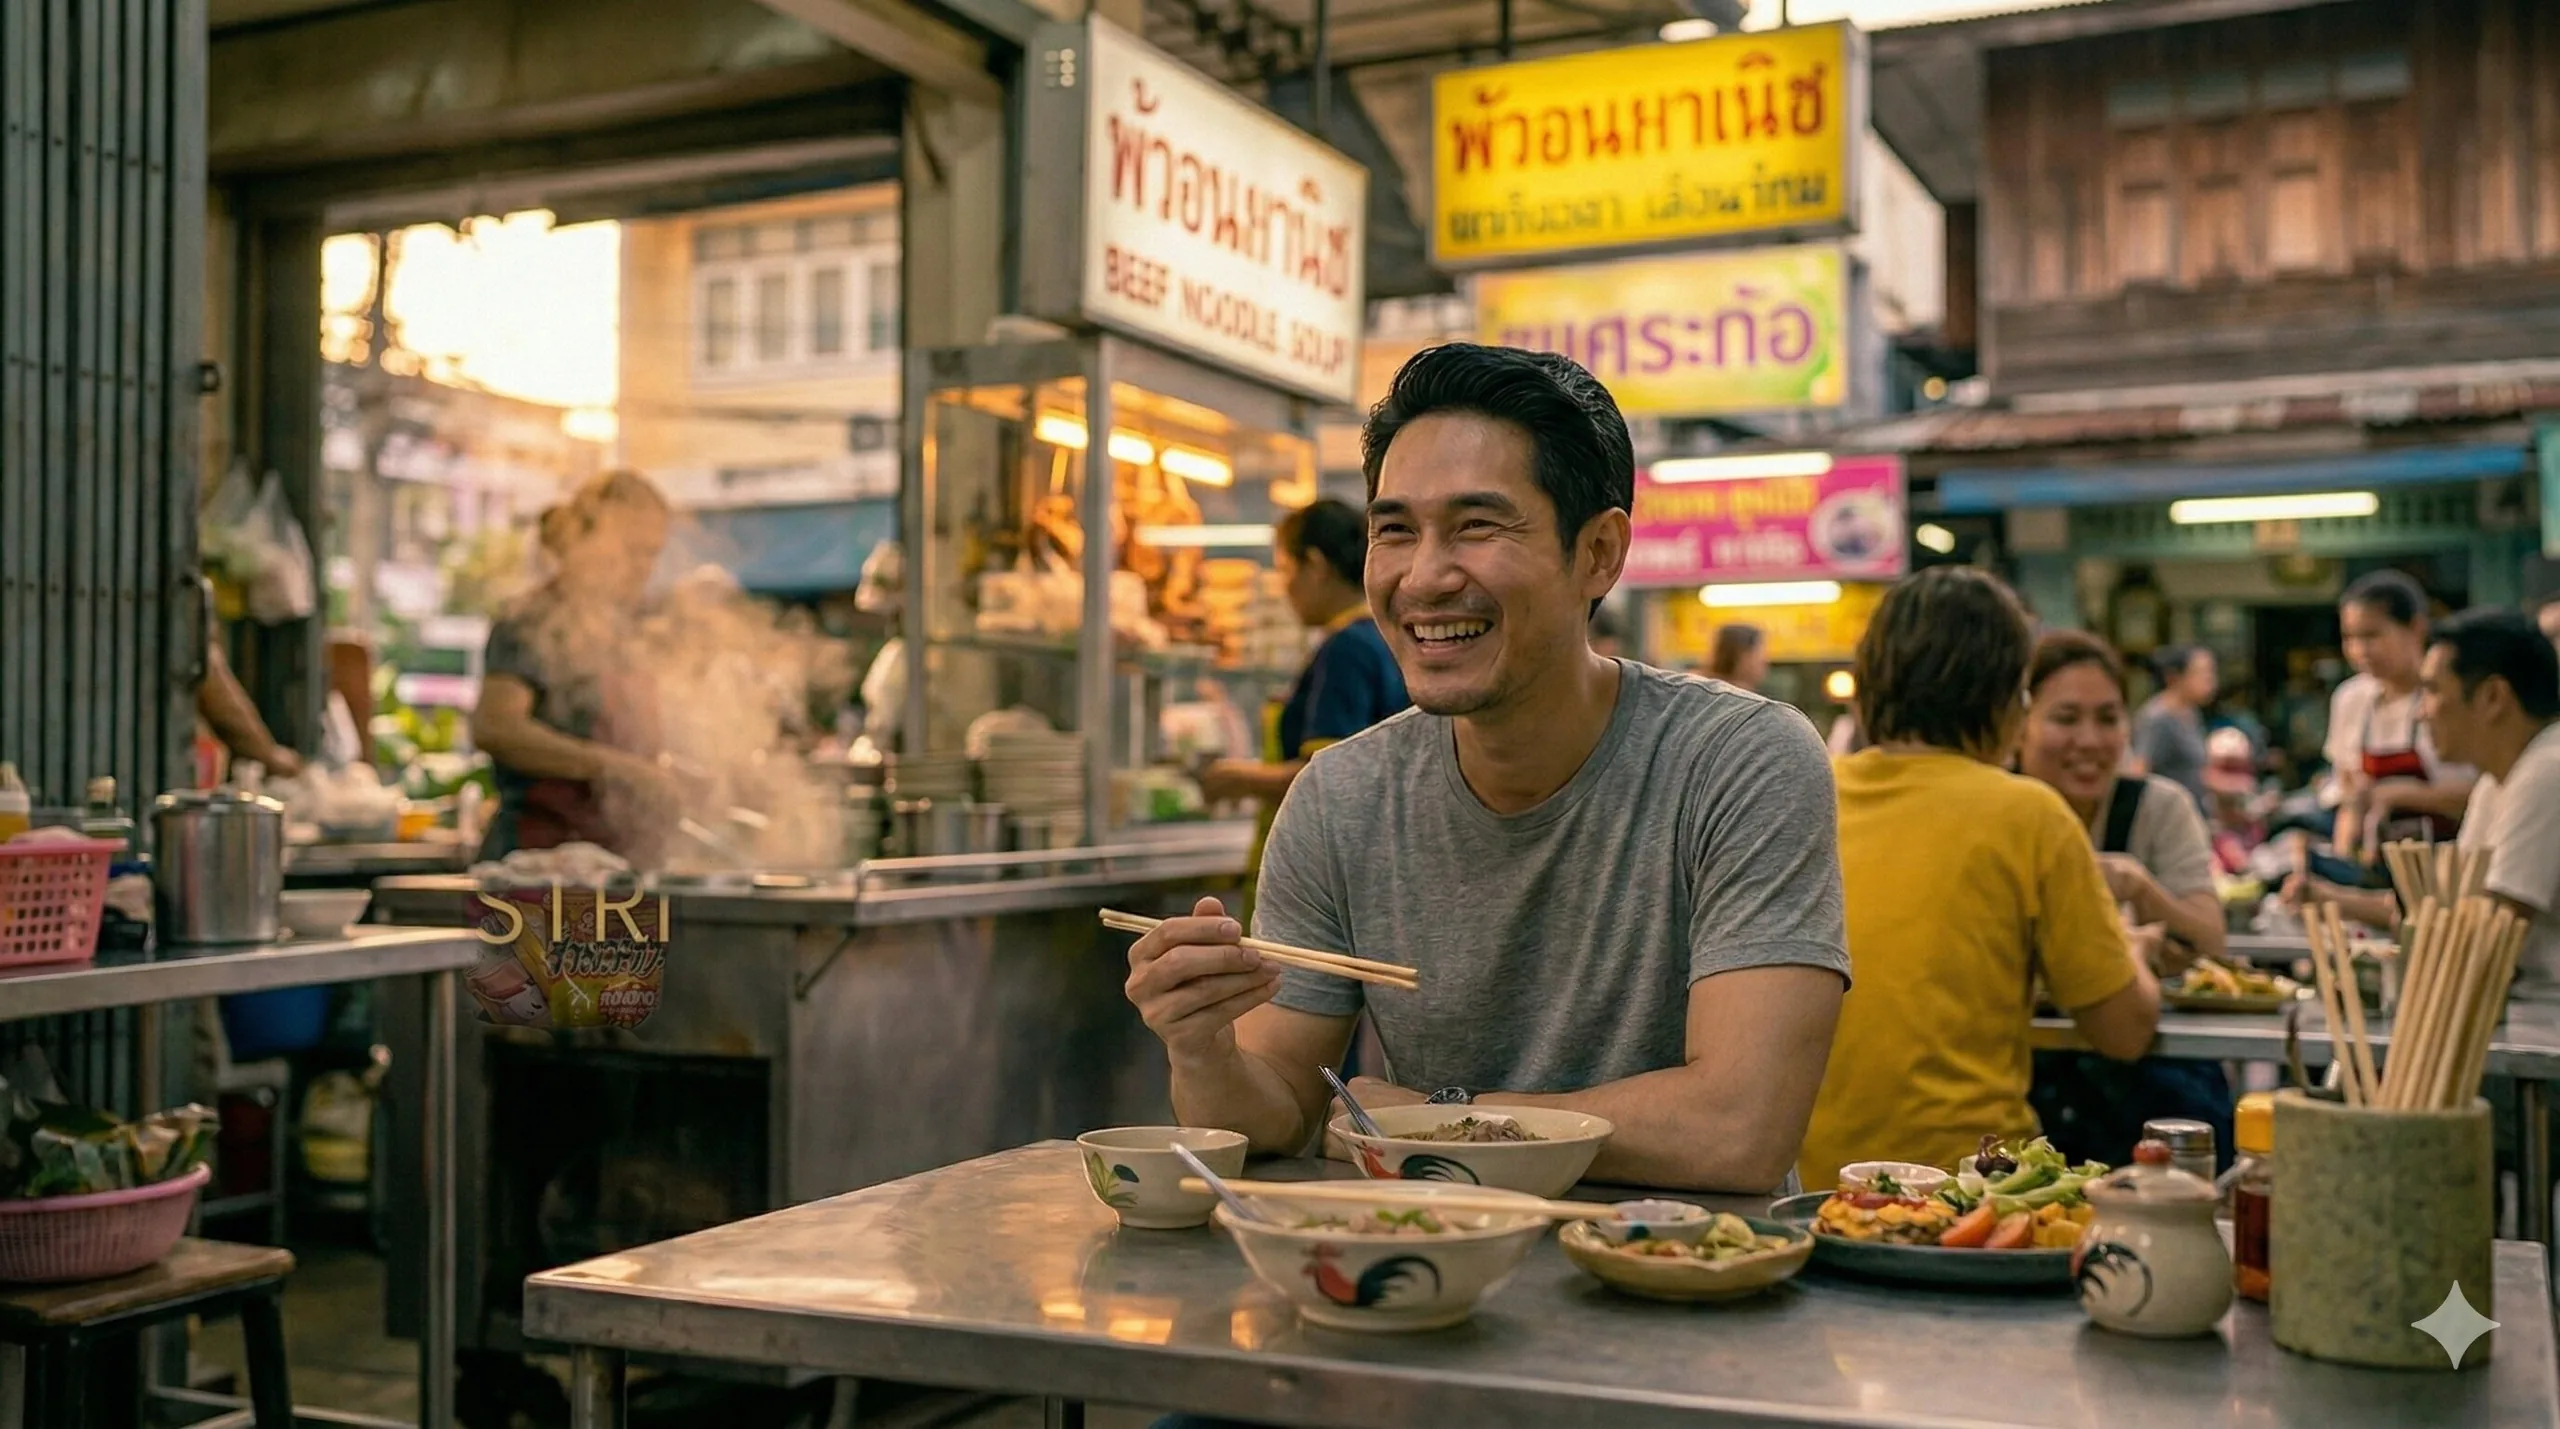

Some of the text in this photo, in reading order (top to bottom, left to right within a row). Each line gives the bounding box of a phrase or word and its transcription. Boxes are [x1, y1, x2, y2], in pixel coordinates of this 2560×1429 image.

[1106, 244, 1347, 374] BEEF NOODLE SOUP
